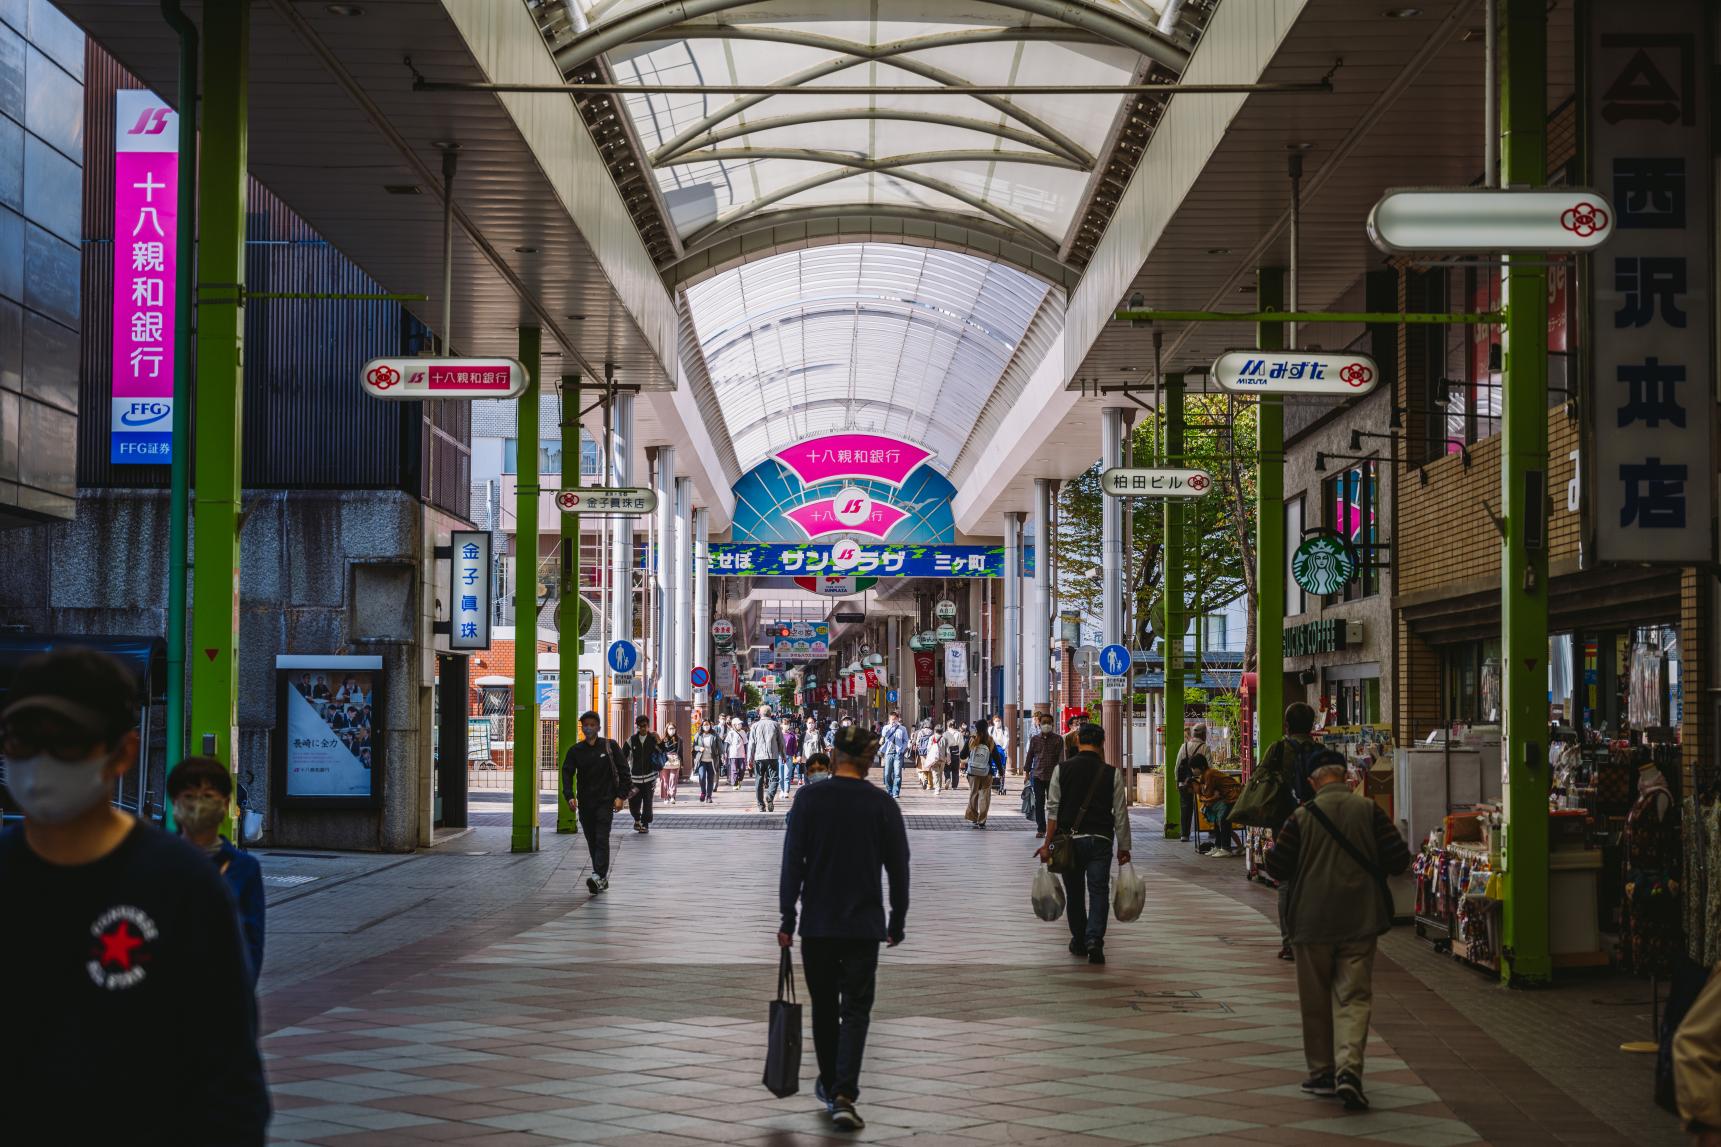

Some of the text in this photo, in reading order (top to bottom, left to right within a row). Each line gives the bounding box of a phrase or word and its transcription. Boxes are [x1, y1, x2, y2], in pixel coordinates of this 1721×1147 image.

[130, 171, 166, 378] 十八親和銀行
[1612, 157, 1688, 529] 西沢本店
[432, 372, 507, 384] 十八親和銀行
[1269, 361, 1328, 380] みずた
[130, 403, 162, 415] FFG
[119, 442, 171, 455] FFG証券
[806, 449, 901, 464] 十八親和銀行
[1113, 475, 1183, 489] 柏田ビル
[811, 510, 884, 522] 十八行
[781, 551, 906, 571] サンラザ
[1307, 619, 1335, 655] COFFEE
